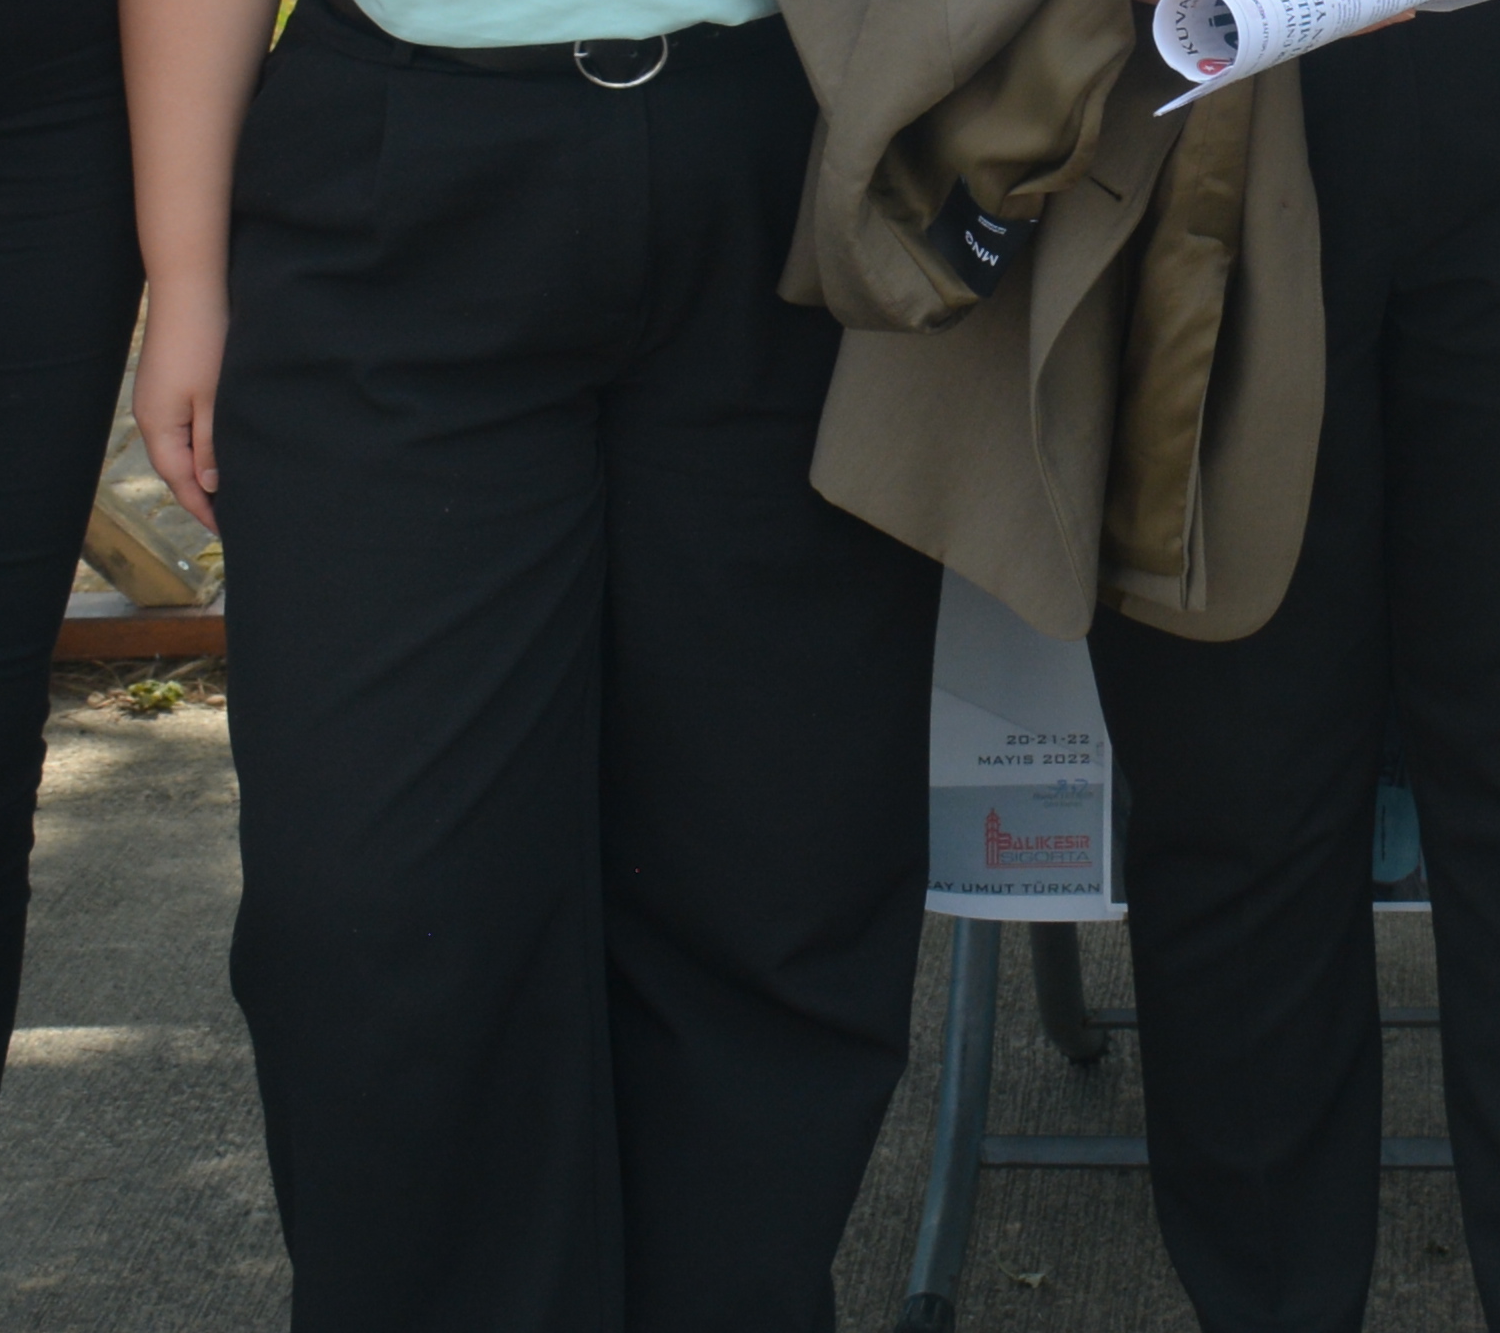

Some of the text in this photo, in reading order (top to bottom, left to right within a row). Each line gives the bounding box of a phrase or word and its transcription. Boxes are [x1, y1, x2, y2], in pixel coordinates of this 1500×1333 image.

[1006, 733, 1090, 745] 20-21-22
[978, 753, 1091, 766] MAYIS 2022
[962, 882, 1014, 894] UMUT
